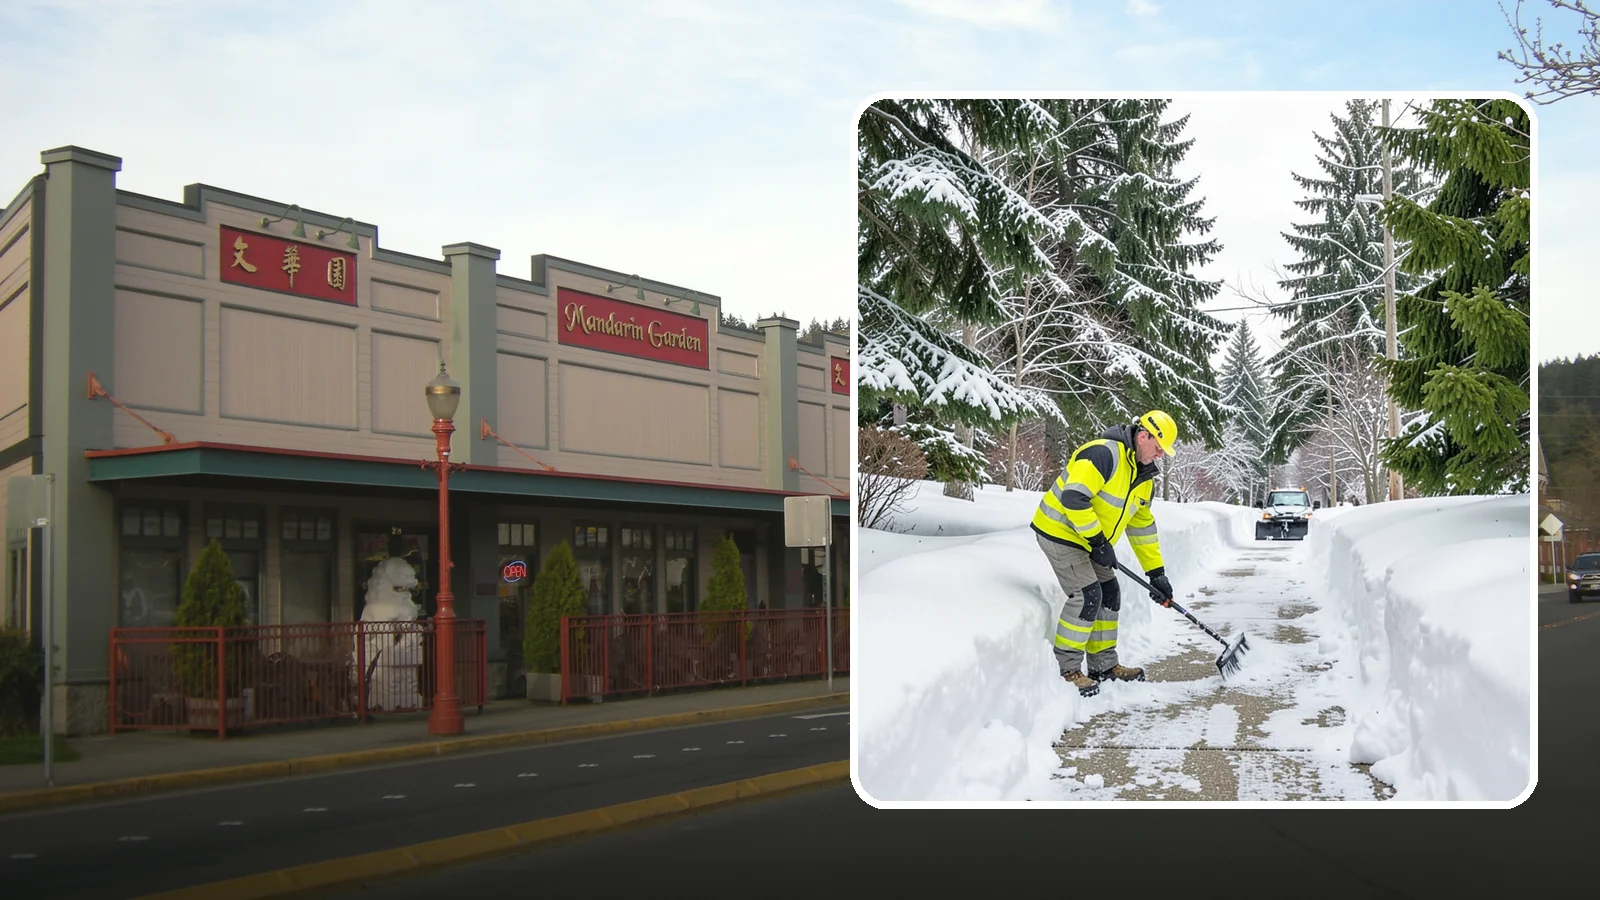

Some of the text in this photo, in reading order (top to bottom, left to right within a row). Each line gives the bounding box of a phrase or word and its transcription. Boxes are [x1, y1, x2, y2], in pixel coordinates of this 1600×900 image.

[564, 302, 702, 352] Mandarin Garden
[503, 565, 527, 578] OPEN
